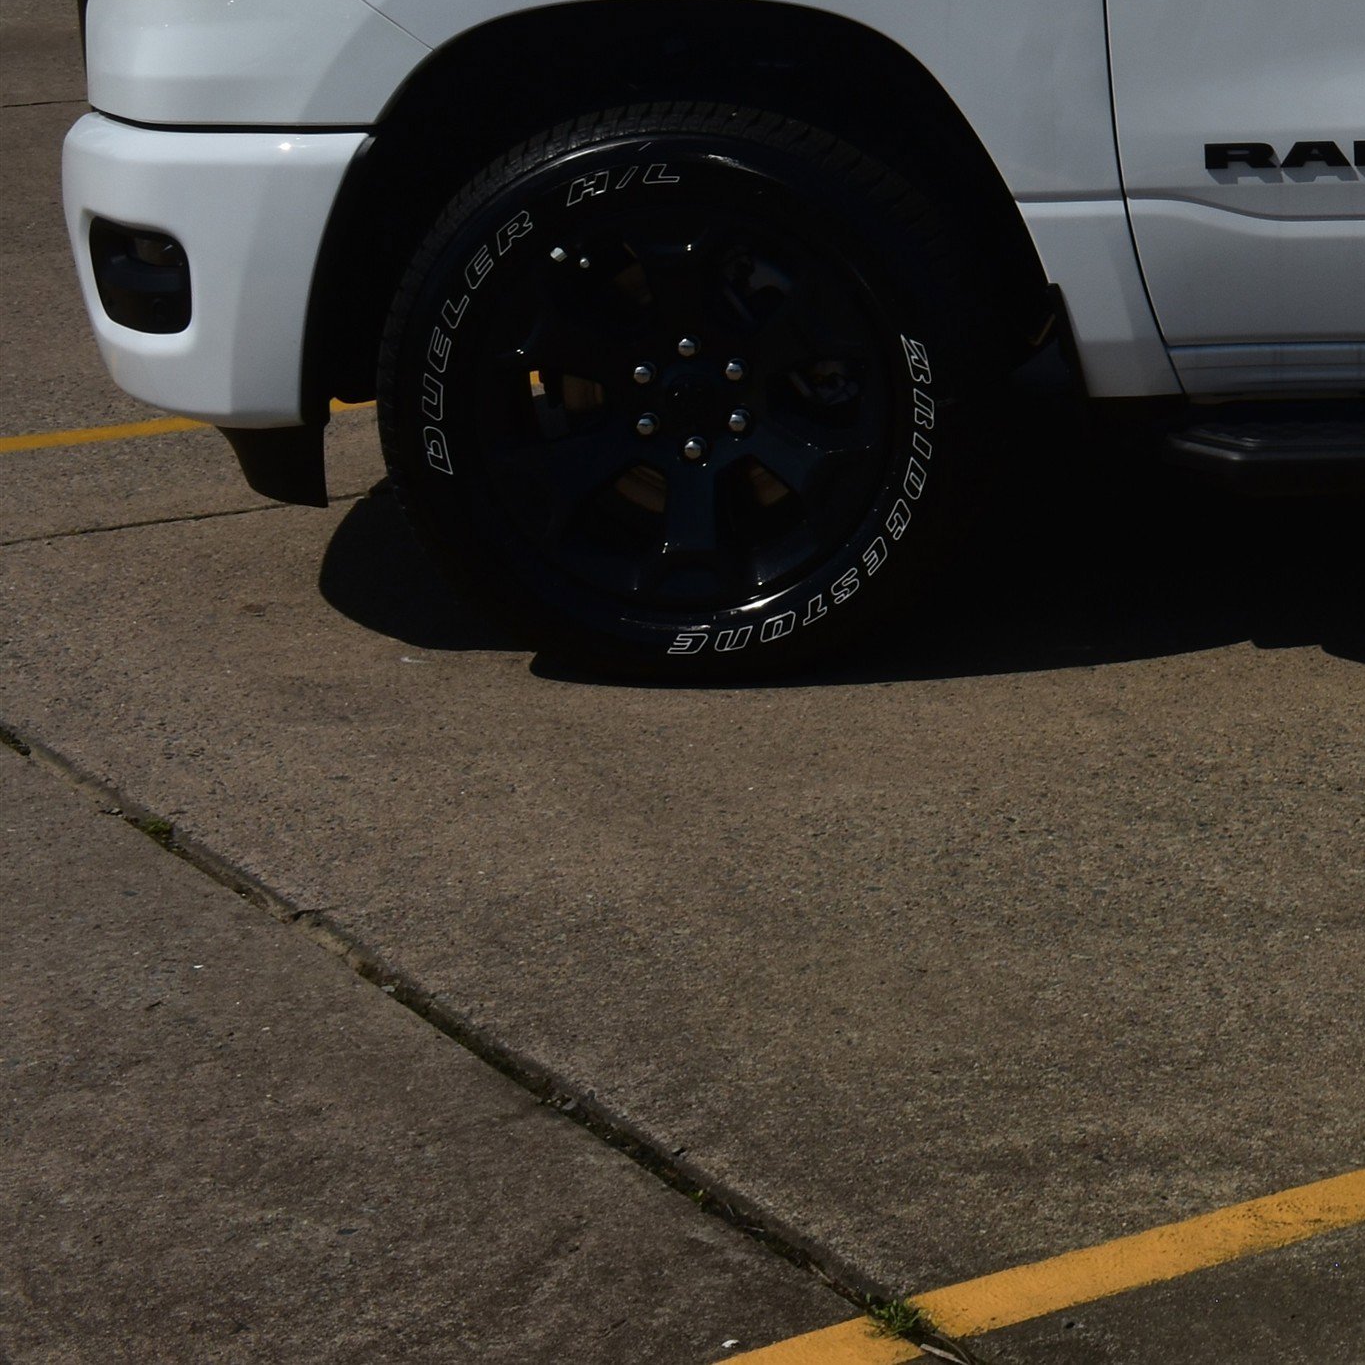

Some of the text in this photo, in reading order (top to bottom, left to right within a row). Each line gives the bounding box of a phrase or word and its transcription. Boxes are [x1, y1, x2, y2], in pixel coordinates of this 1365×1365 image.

[421, 163, 681, 476] DUELER H/L
[667, 334, 936, 655] BRIDGESTONE
